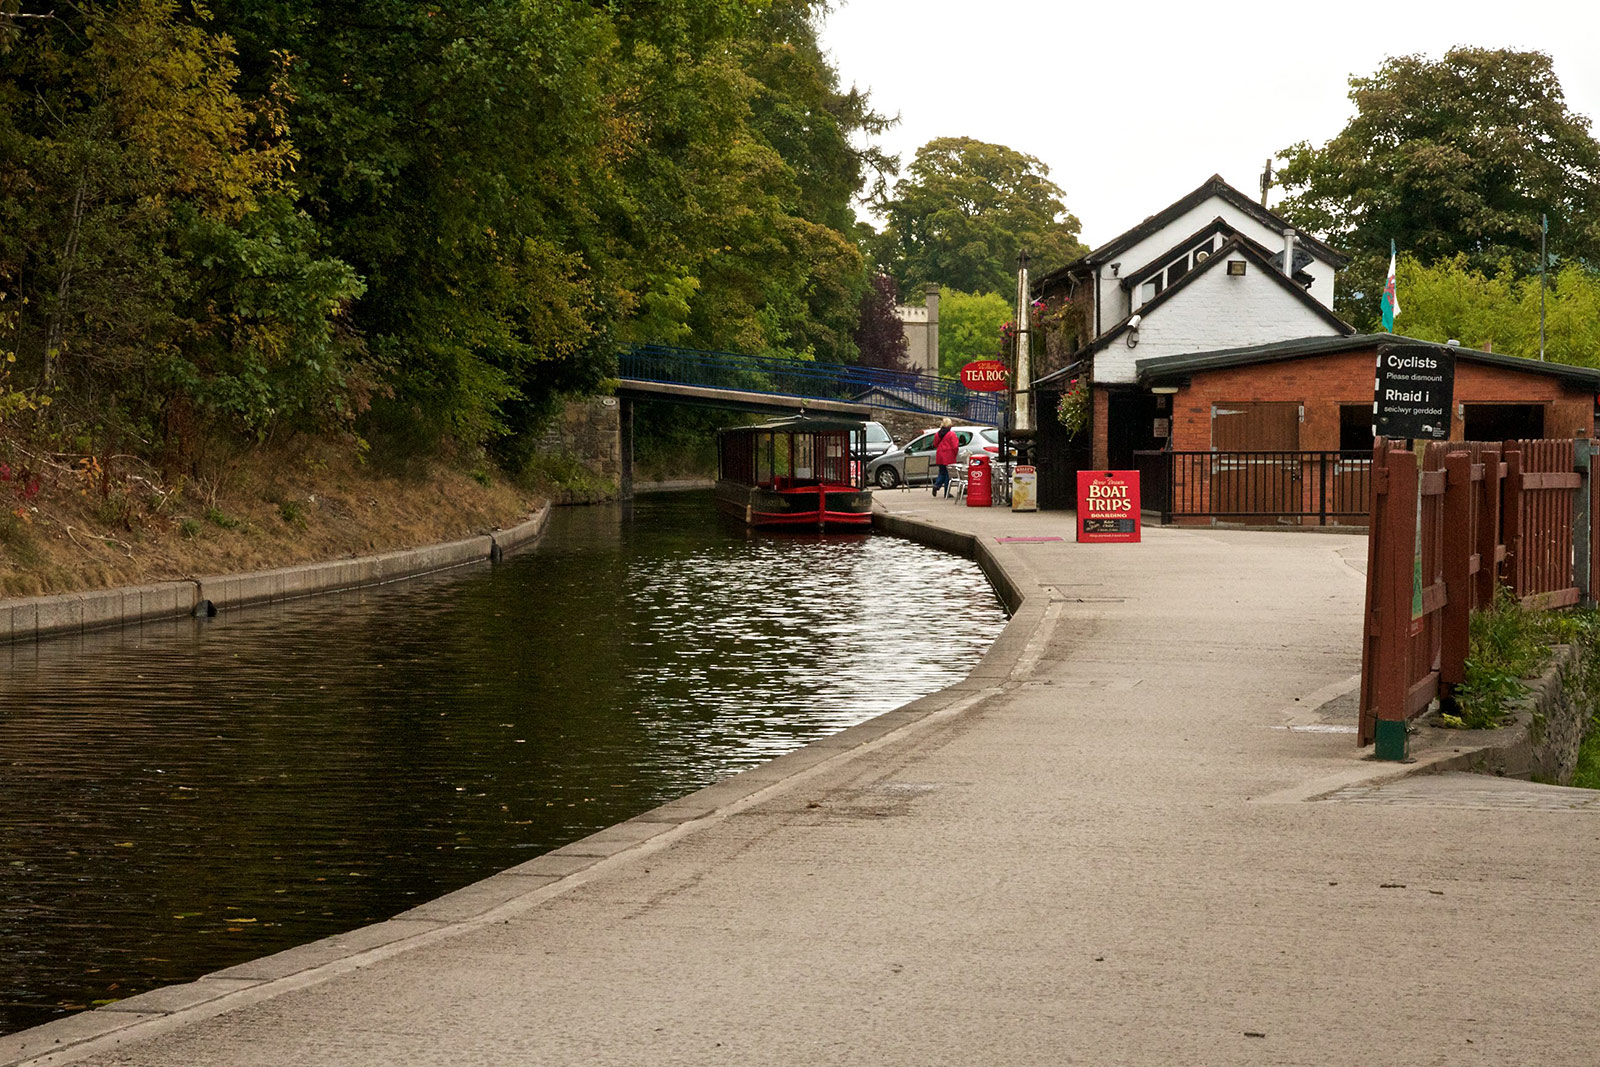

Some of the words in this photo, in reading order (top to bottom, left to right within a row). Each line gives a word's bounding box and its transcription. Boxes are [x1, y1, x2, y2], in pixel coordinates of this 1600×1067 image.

[1387, 355, 1437, 369] Cyclists
[965, 370, 985, 381] TEA
[1386, 372, 1410, 381] Please
[1410, 373, 1443, 382] dismount
[1385, 389, 1422, 402] Rhaid
[1425, 391, 1430, 402] i
[1384, 406, 1412, 415] seiclwyr
[1413, 408, 1443, 416] gerdded
[1089, 485, 1128, 498] BOAT
[1086, 498, 1131, 511] TRIPS
